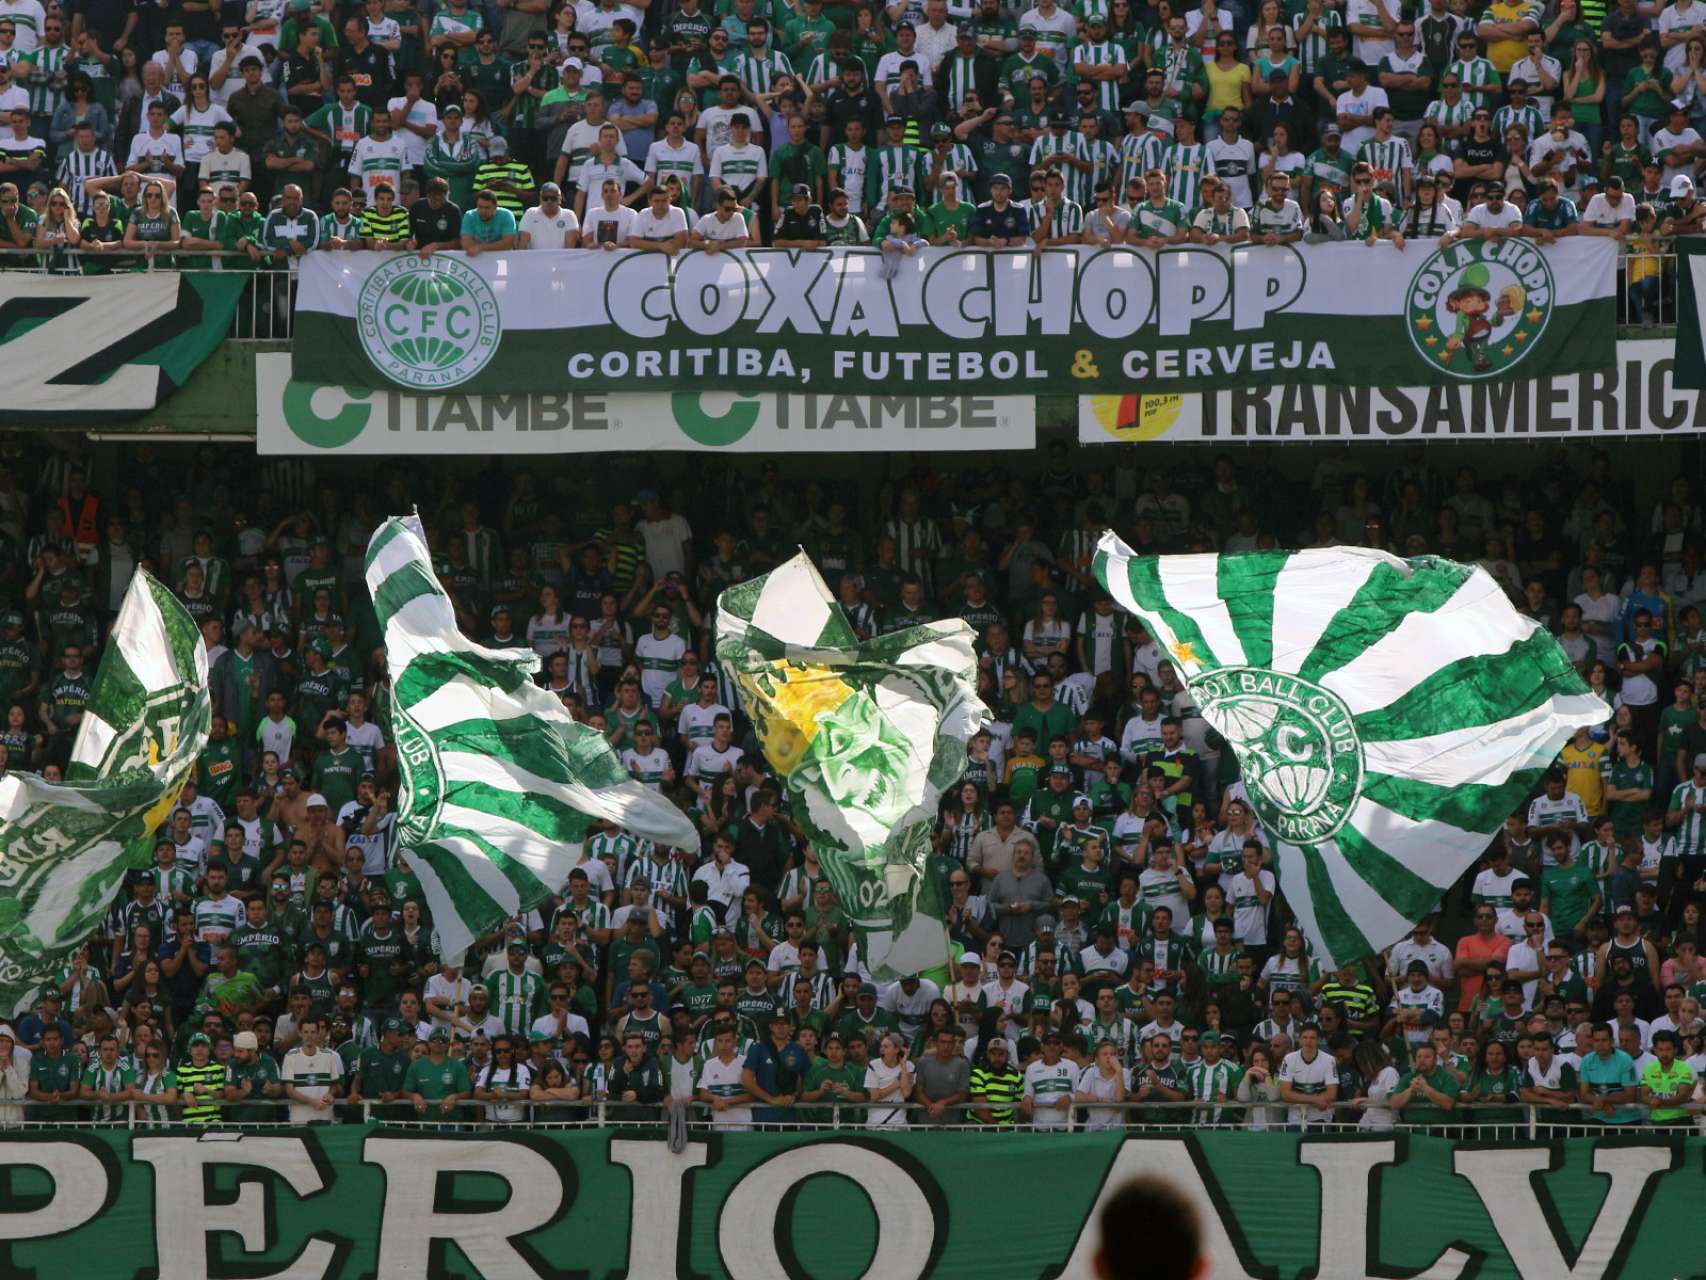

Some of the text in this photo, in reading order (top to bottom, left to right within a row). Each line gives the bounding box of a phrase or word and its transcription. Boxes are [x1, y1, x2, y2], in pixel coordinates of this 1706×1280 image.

[1467, 149, 1494, 158] RVCA
[362, 256, 497, 347] CORITIBA FOOT BALL CLUB
[1413, 239, 1549, 310] COXA CHOPP
[384, 303, 472, 340] CFC
[567, 341, 1336, 384] CORITIBA, FUTEBOL & CERVEJA
[52, 682, 90, 699] IMPÉRIO
[1240, 673, 1301, 703] BALL
[1308, 695, 1355, 753] CLUB
[1053, 1137, 1673, 1280] ALV
